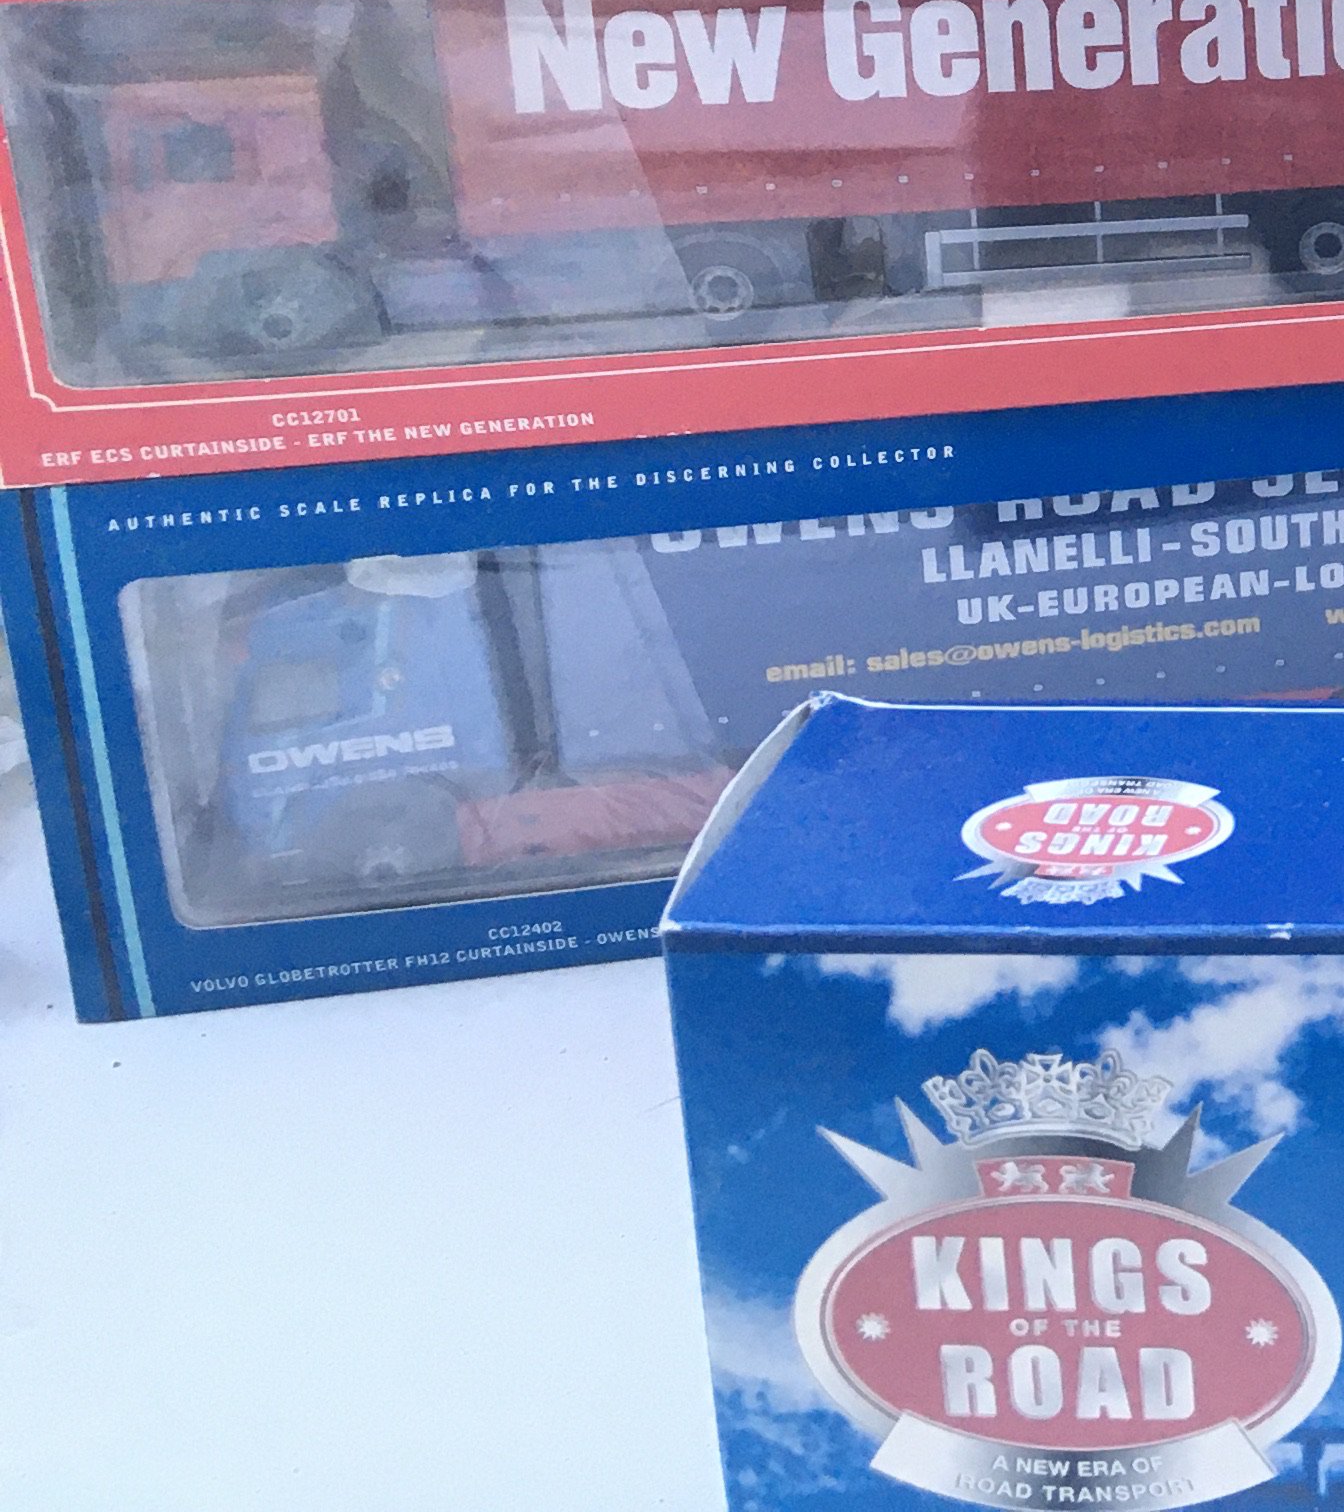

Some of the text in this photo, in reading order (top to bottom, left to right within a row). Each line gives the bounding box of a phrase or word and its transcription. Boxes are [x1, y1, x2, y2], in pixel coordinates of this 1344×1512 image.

[41, 411, 596, 469] ERF ECS CURTAINSIDE ERF THE NEW GENERATION
[271, 406, 361, 428] CC12701
[107, 444, 957, 533] AUTHENTIC SCALE REPLICA FOR THE DISCERNING COLLECTOR
[766, 656, 857, 685] email:
[866, 616, 1261, 676] sales@owens-logistics.com
[248, 724, 456, 775] OWENS
[1041, 802, 1174, 827] ROAD
[1013, 831, 1169, 857] KINGS
[488, 919, 563, 941] CC12402
[190, 925, 662, 994] VOLVO GLOBETROTTER FH12 CURTAINSIDE OWENS
[910, 1234, 1214, 1318] KINGS
[1010, 1317, 1122, 1338] OF THE
[939, 1343, 1197, 1423] ROAD
[992, 1454, 1164, 1478] A NEW ERA OF
